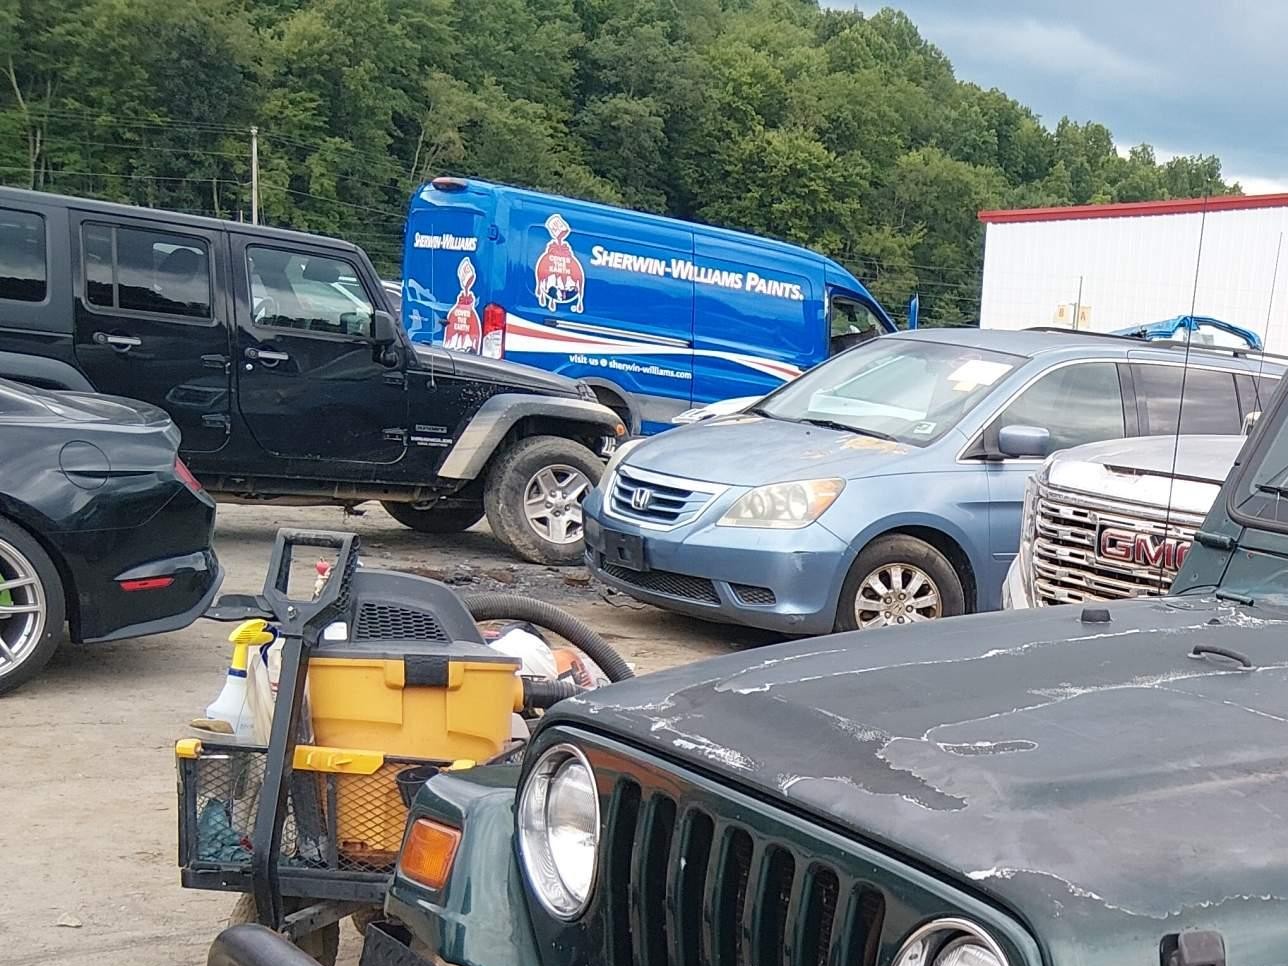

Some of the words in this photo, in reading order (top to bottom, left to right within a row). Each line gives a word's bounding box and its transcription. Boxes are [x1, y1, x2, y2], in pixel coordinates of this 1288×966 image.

[414, 232, 477, 251] SHERWIN-WILLIAMS
[590, 246, 742, 289] SHERWIN-WILLIAMS
[568, 354, 588, 365] visit
[588, 358, 599, 367] us
[608, 360, 692, 380] sherwin-williams.com
